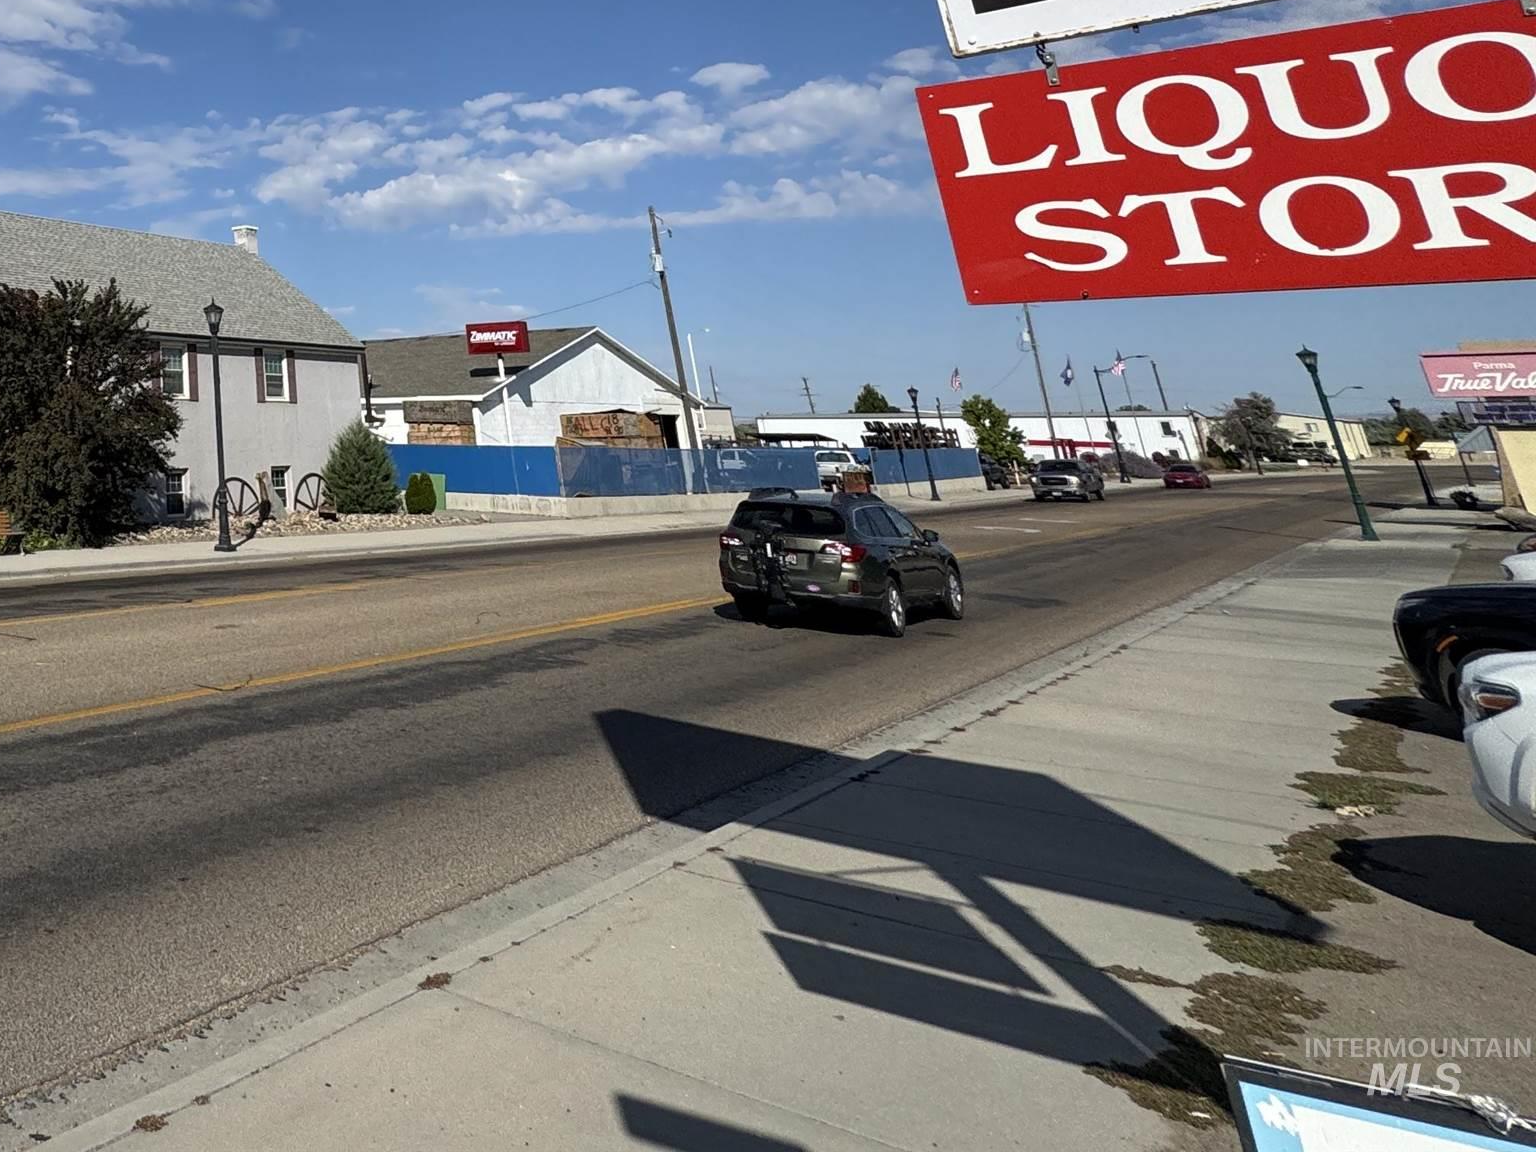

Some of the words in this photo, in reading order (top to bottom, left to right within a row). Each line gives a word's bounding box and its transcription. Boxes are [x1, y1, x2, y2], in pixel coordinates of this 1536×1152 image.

[938, 31, 1536, 178] LIQUO
[1014, 162, 1536, 272] STOR
[1472, 361, 1516, 370] Parma
